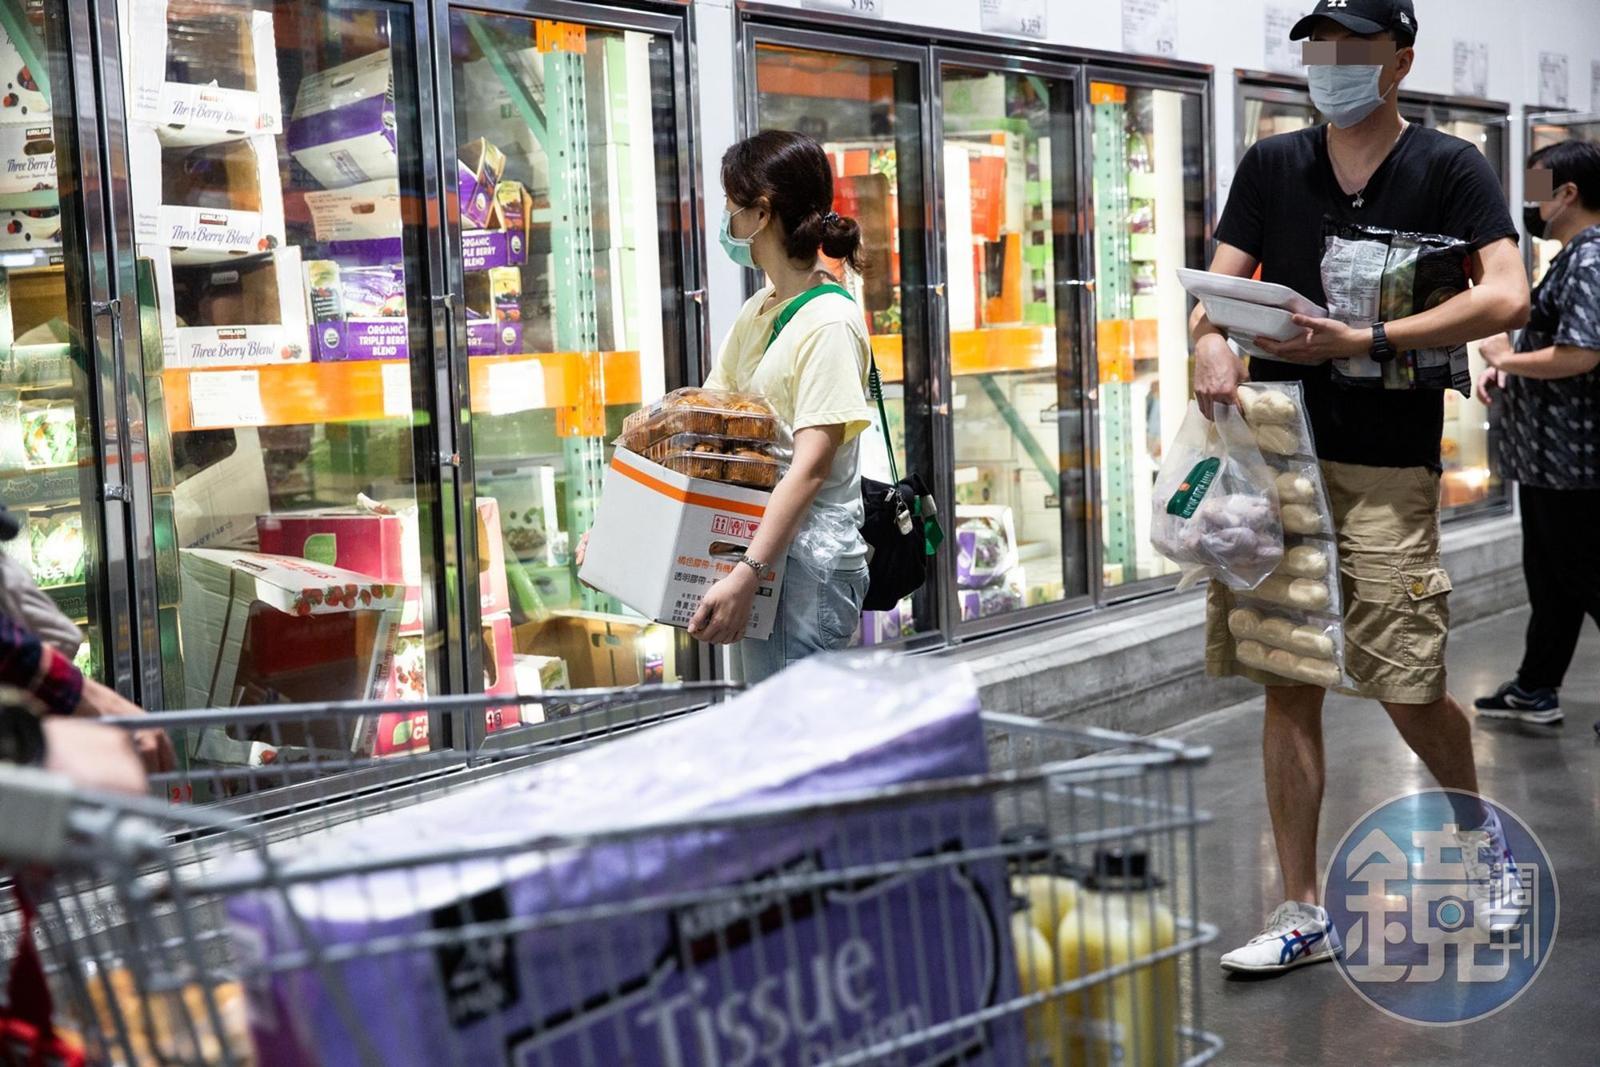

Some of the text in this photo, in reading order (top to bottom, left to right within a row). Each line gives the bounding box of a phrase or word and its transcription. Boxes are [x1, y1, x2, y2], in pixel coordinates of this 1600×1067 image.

[196, 227, 225, 245] Berry
[225, 231, 254, 246] Blend
[476, 246, 496, 256] BERRY
[464, 257, 485, 267] BLEND
[368, 324, 404, 335] ORGANIC
[360, 335, 406, 346] TRIPLE BERR
[191, 341, 276, 359] Three Berry Blend
[372, 346, 397, 356] BLEND
[634, 936, 877, 1067] Tissue
